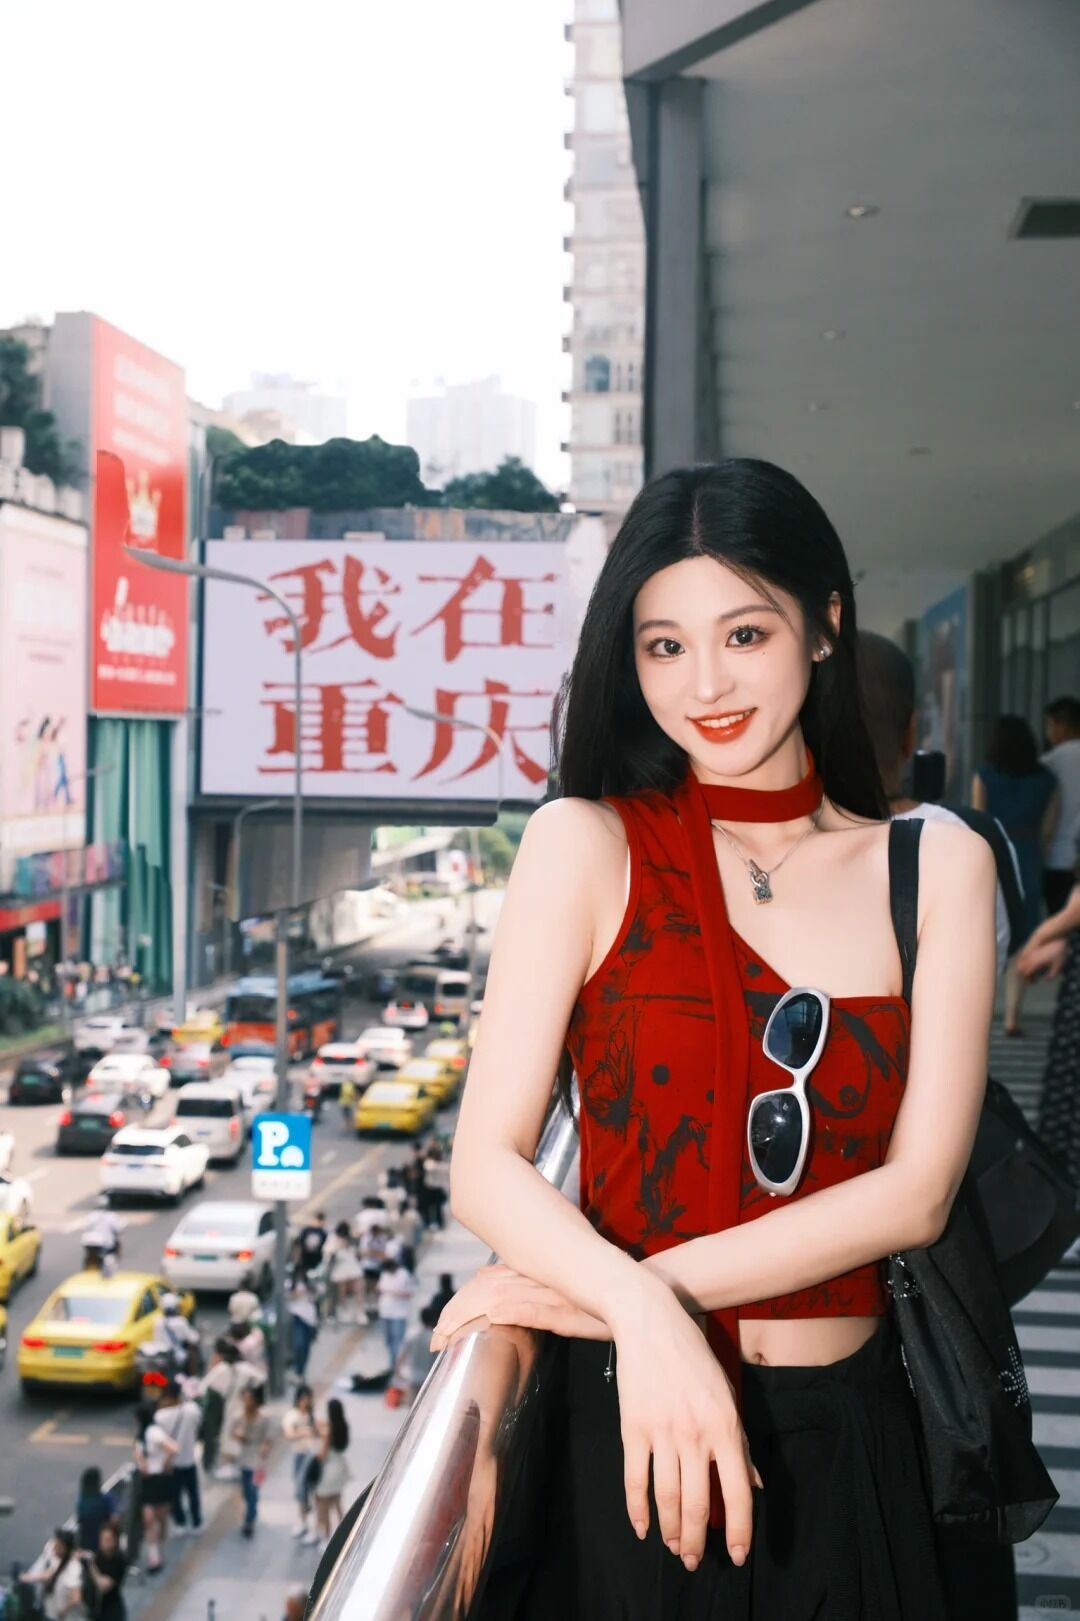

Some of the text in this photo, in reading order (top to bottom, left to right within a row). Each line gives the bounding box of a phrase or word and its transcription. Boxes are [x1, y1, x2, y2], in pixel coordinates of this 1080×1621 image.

[256, 553, 558, 661] 我在
[257, 678, 553, 784] 重庆
[257, 1121, 289, 1166] P
